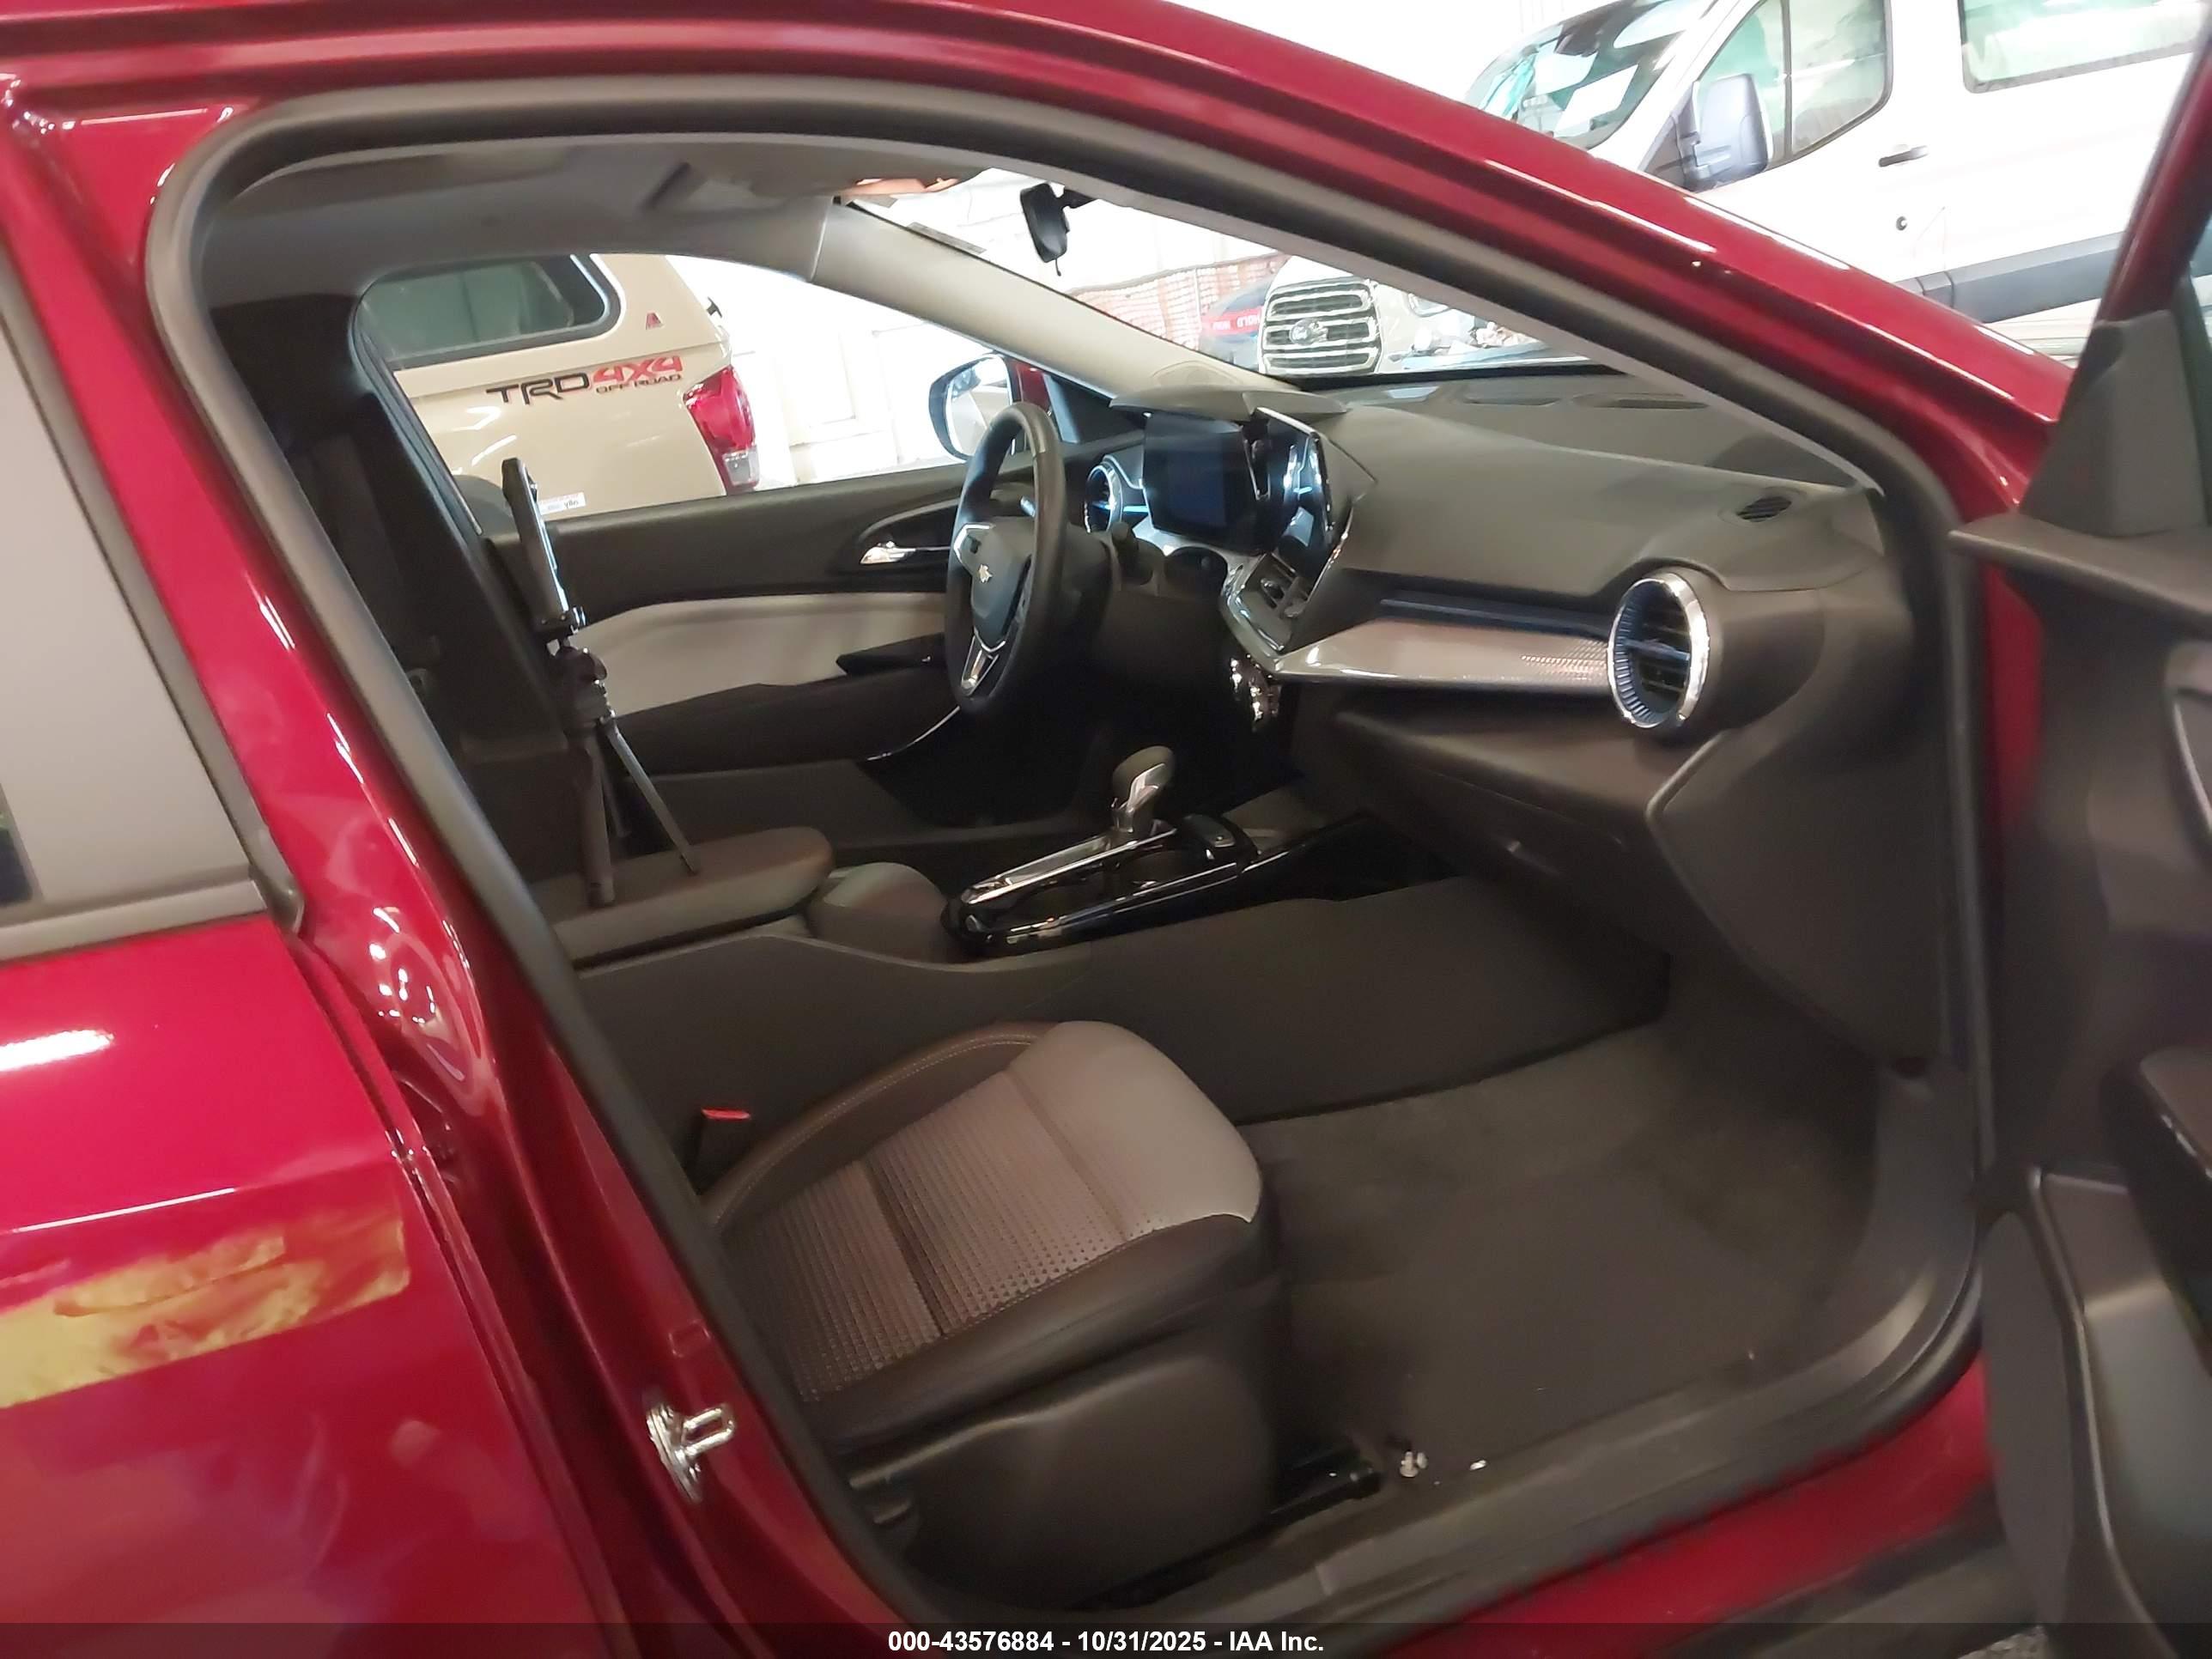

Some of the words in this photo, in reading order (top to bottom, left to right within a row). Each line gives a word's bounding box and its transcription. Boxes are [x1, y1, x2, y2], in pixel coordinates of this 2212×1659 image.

[486, 372, 590, 405] TRD
[596, 383, 629, 394] OFF
[634, 373, 682, 388] ROAD
